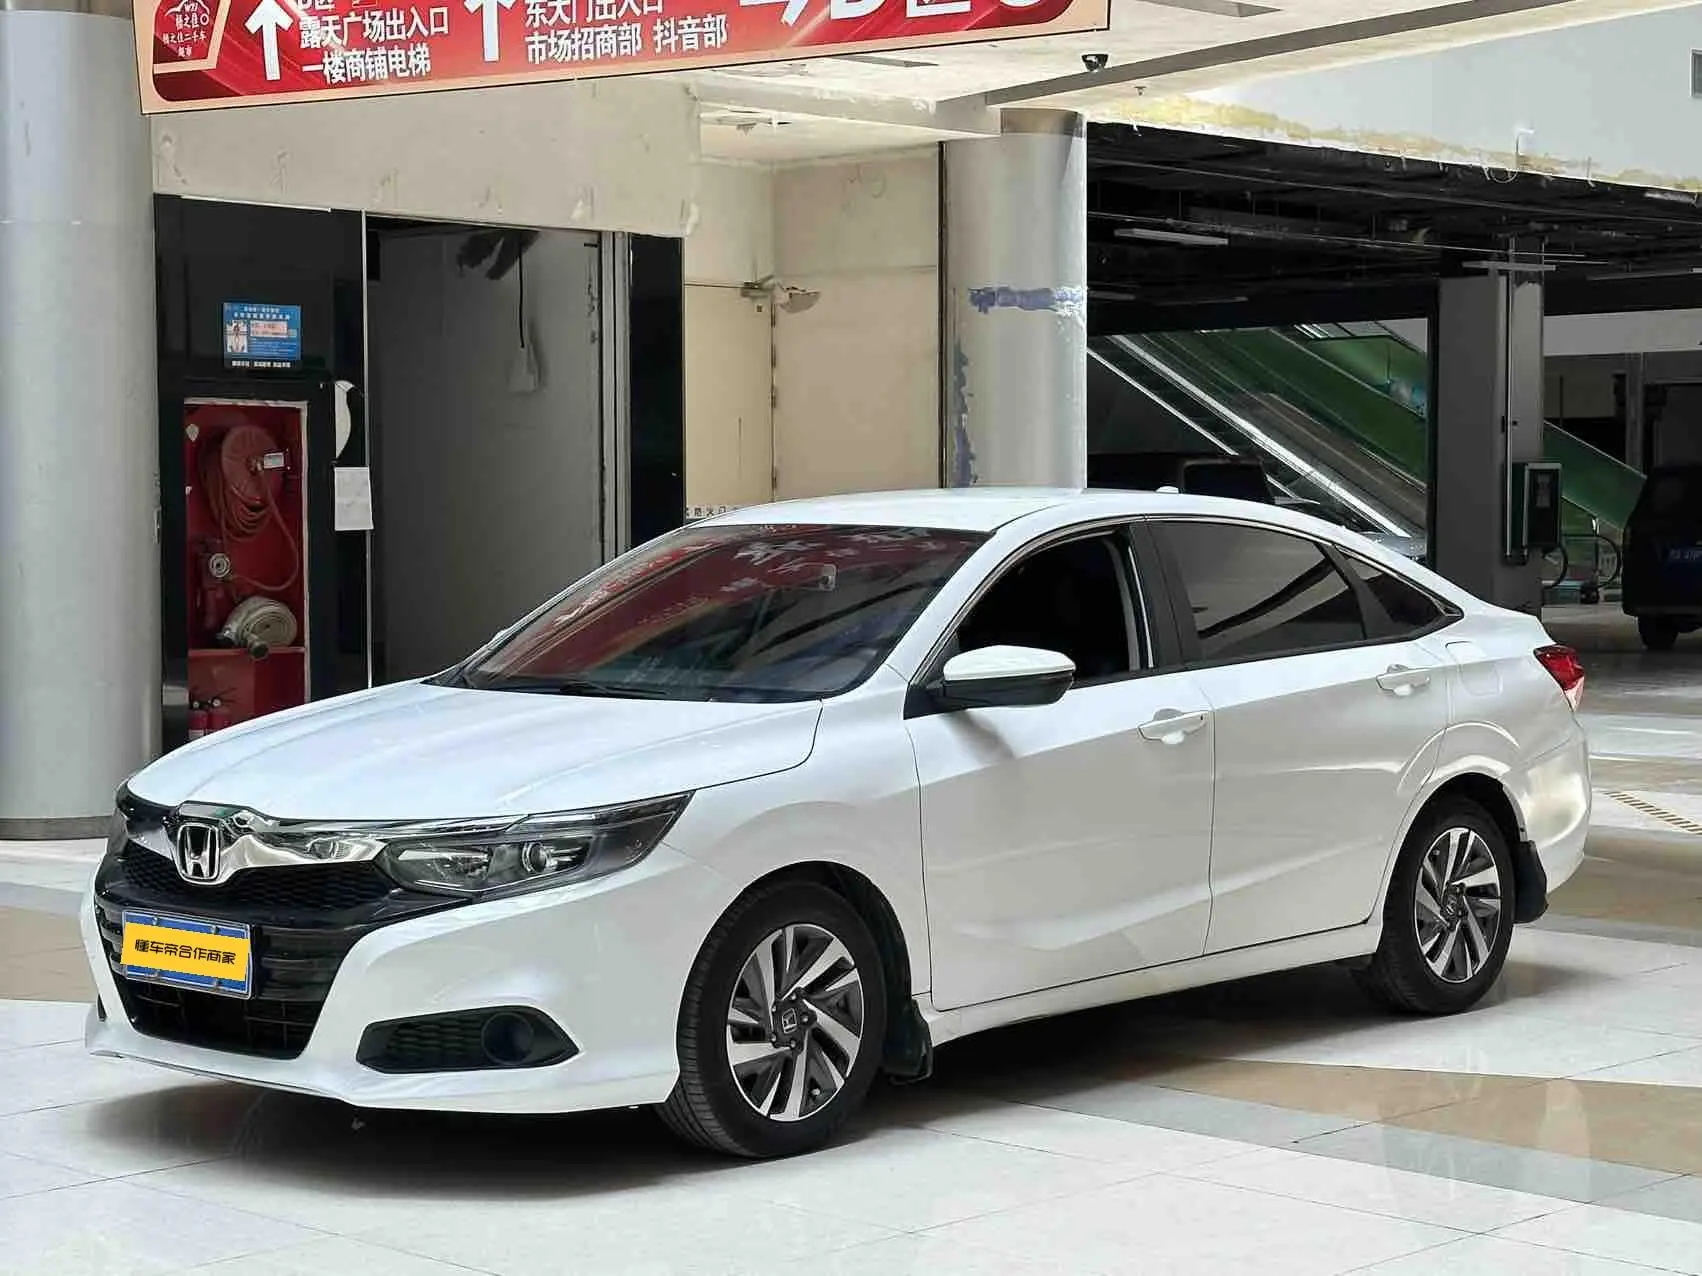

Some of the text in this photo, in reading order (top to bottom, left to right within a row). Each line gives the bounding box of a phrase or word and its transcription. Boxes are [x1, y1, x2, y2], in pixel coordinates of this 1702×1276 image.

[299, 6, 449, 49] 露天广场出入口
[525, 14, 730, 65] 市场招商部 抖音部
[302, 42, 432, 84] 一楼商铺电梯
